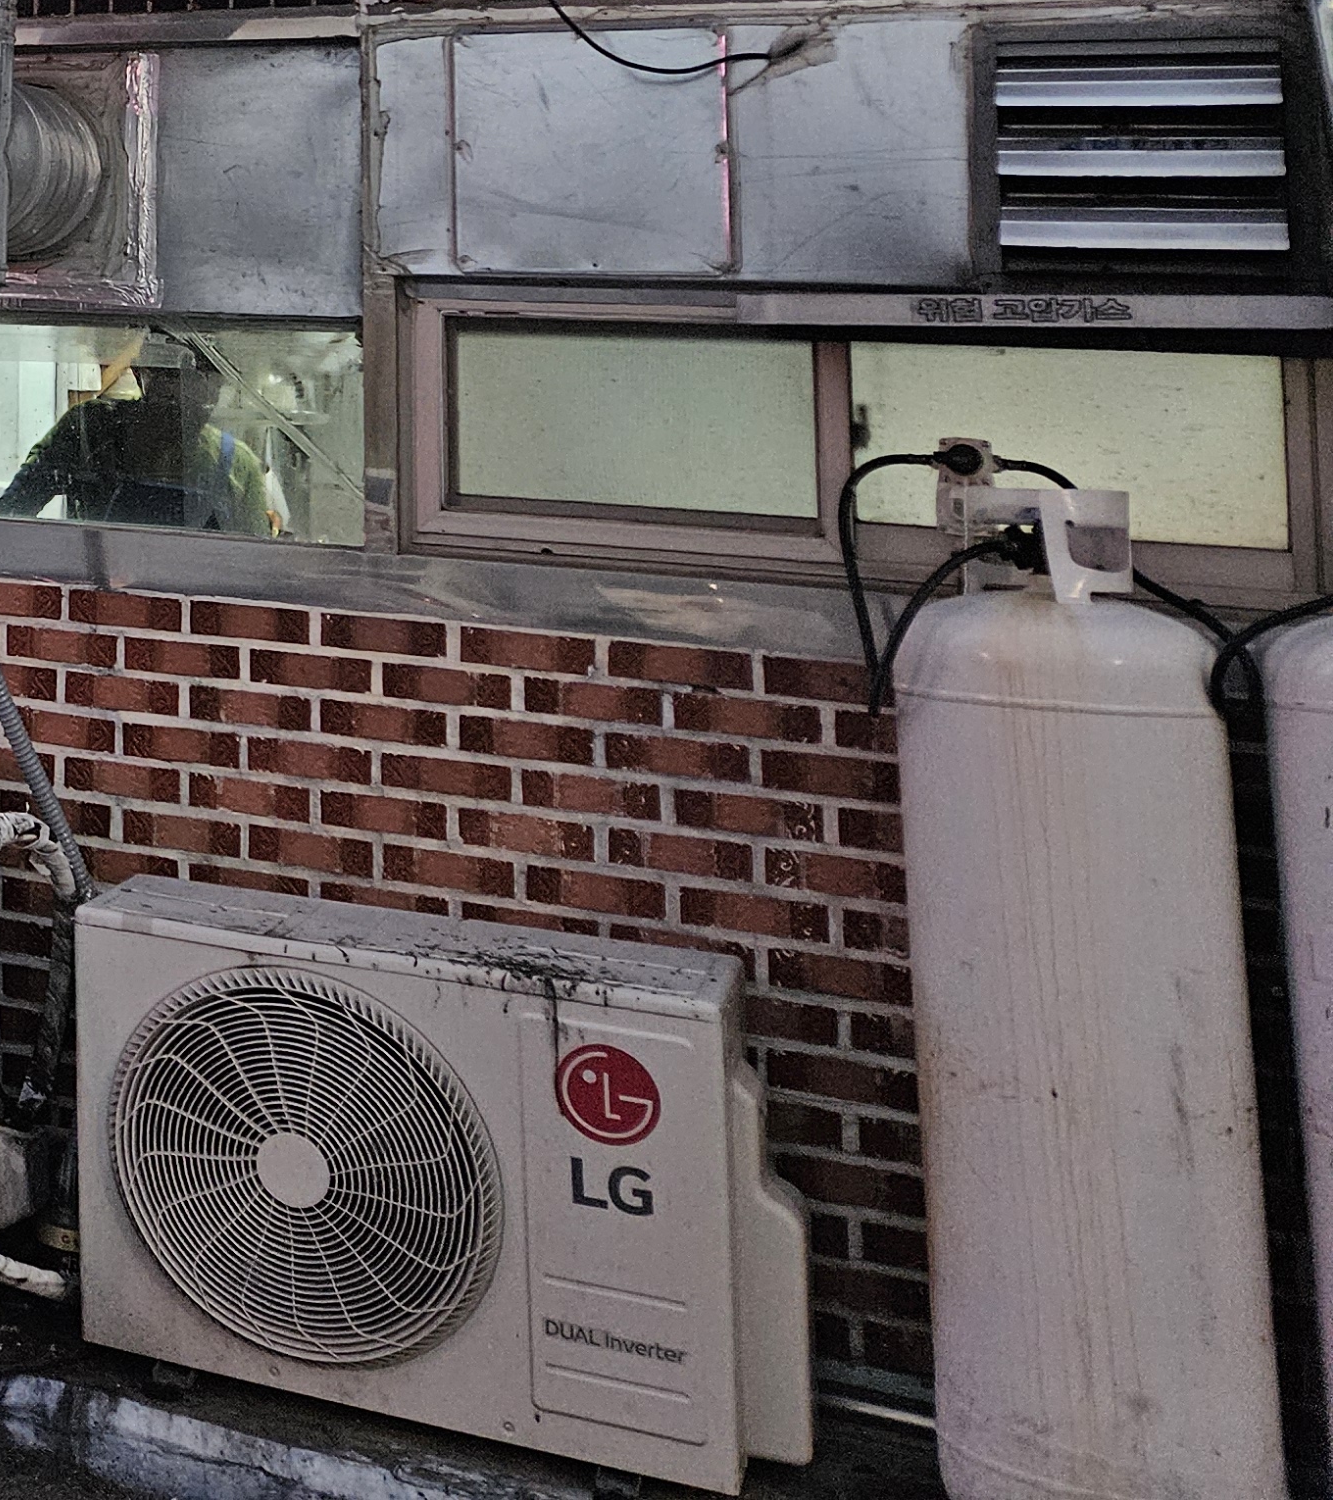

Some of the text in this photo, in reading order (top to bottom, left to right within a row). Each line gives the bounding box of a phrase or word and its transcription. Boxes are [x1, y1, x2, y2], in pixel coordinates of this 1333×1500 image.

[916, 298, 1131, 323] 위험 고압가스
[570, 1156, 654, 1216] LG
[544, 1319, 687, 1364] DUAL Inverter
